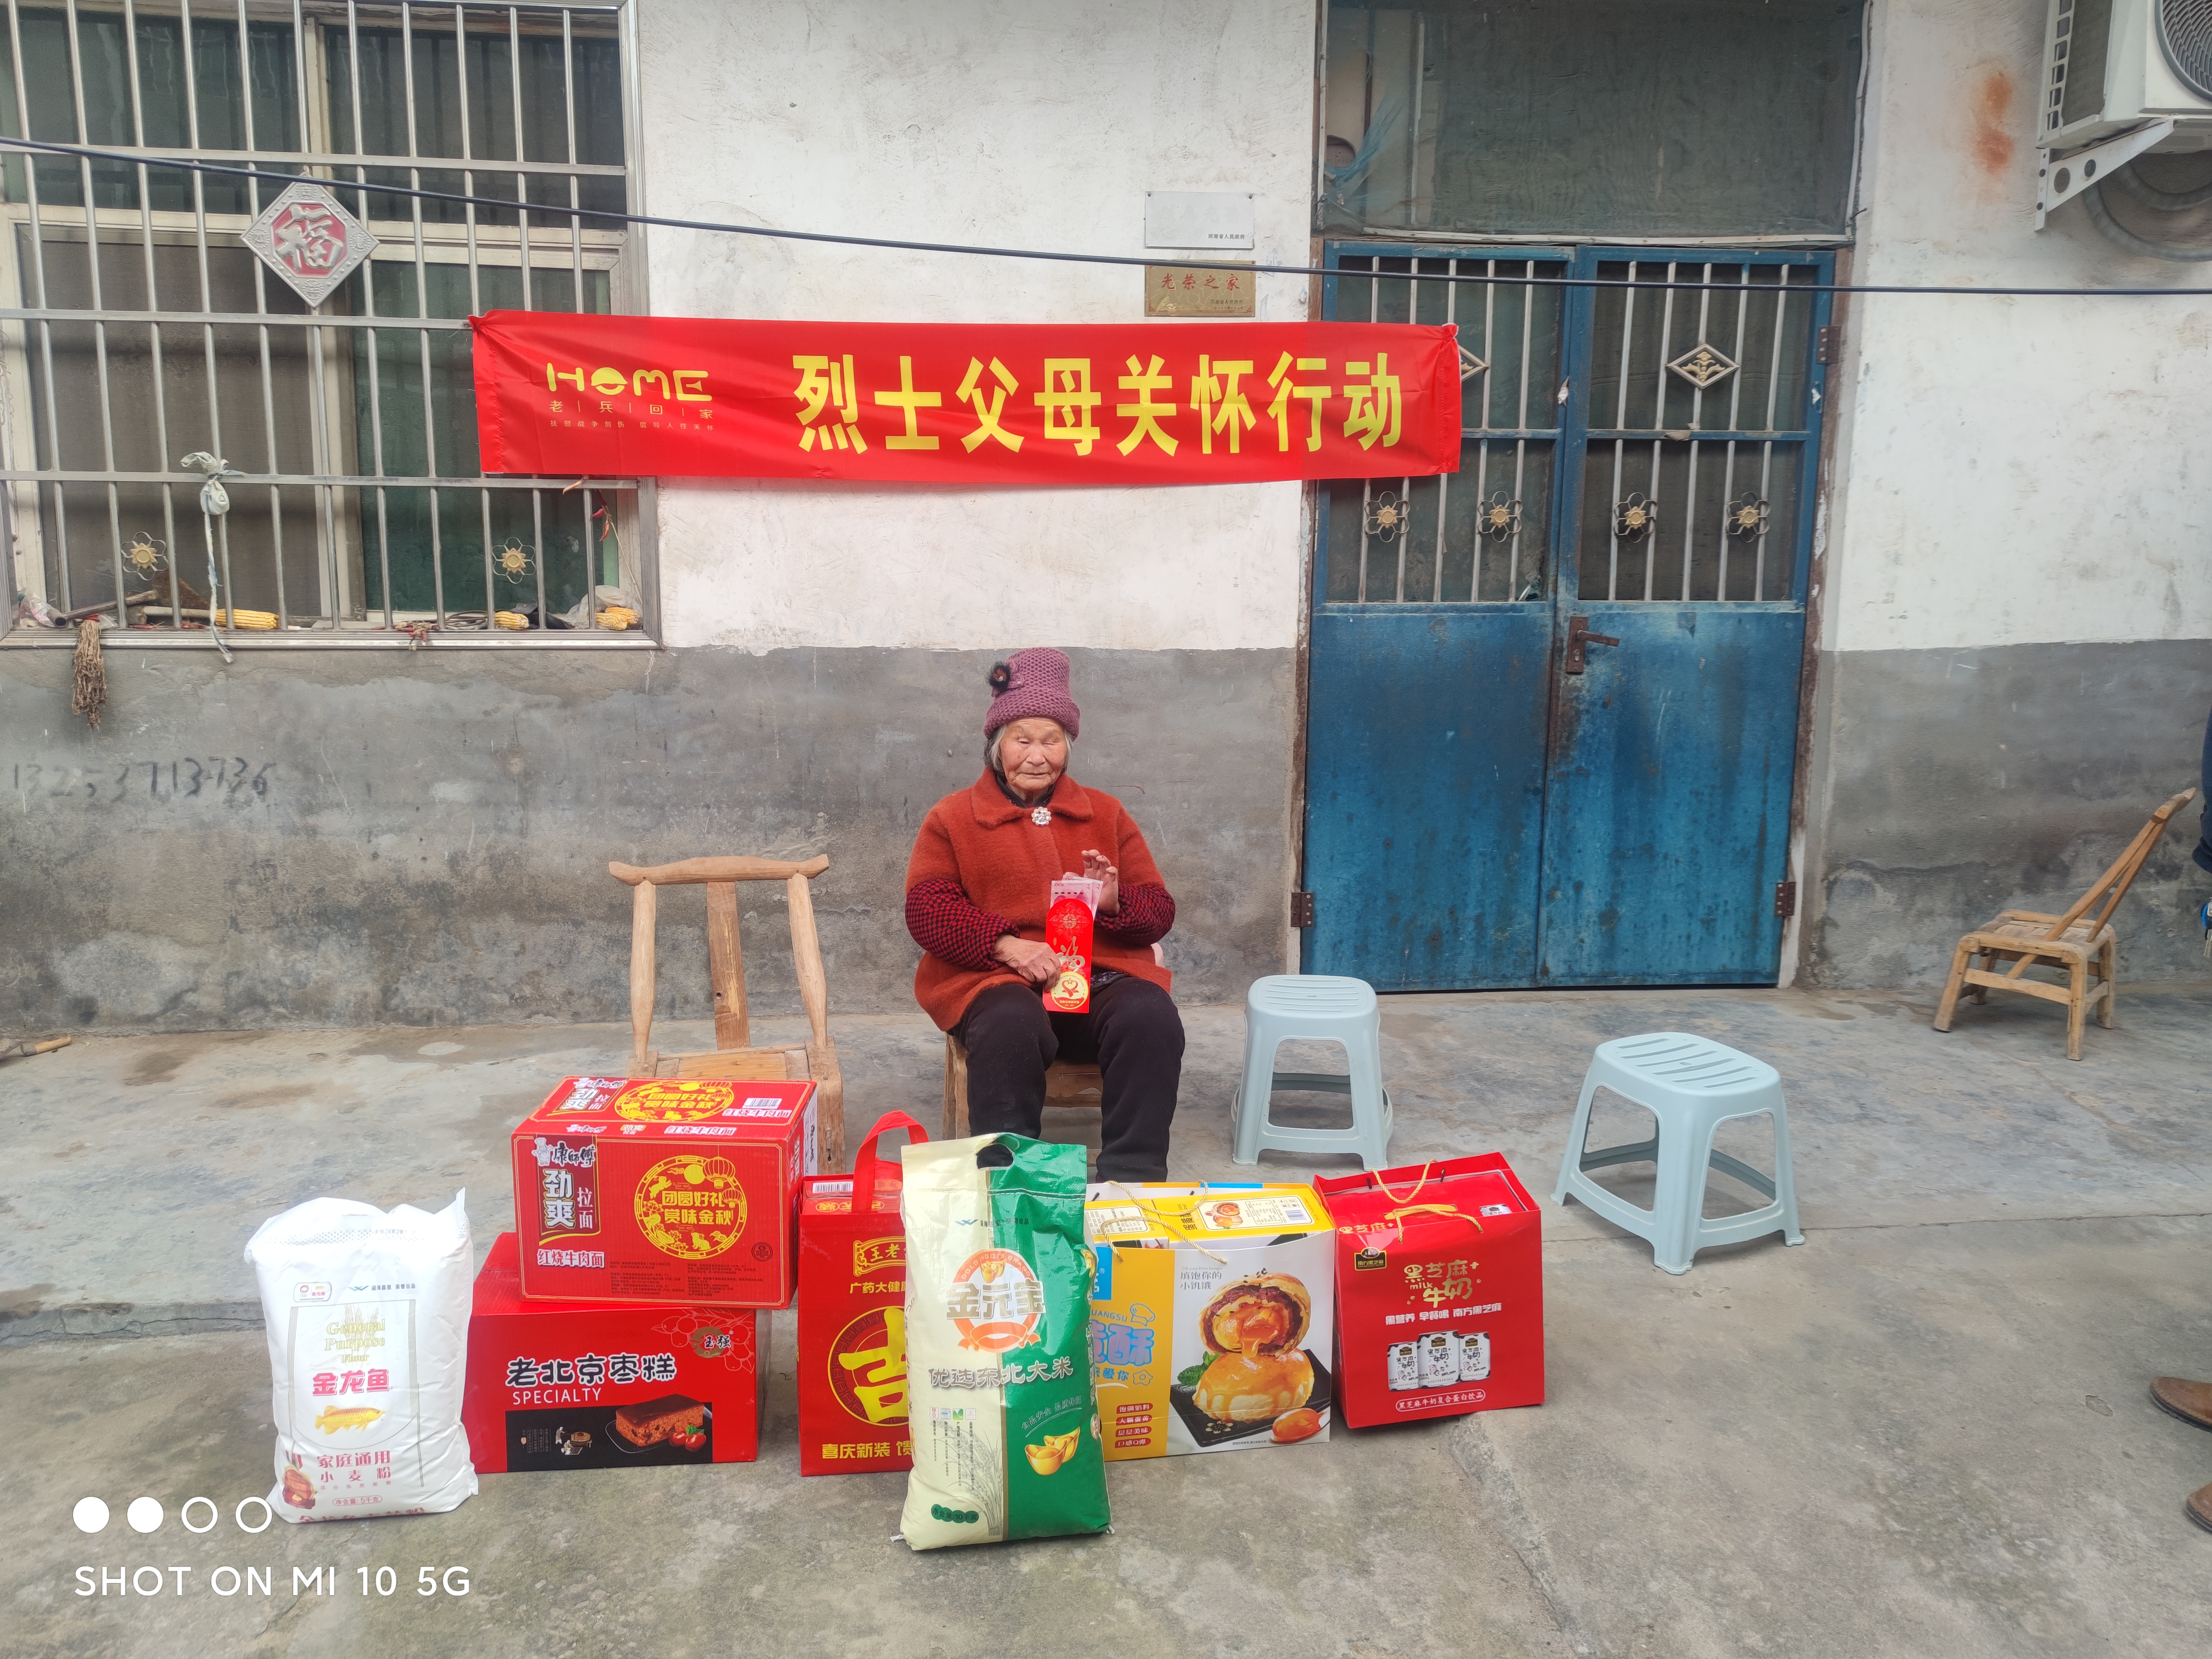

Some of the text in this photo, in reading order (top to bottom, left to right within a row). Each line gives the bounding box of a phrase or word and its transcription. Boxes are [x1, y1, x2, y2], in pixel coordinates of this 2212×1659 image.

[1161, 273, 1240, 291] 光荣之家
[546, 362, 712, 401] HOME
[792, 351, 1402, 456] 烈士父母关怀行动
[640, 422, 714, 431] 倡导人性关怀
[644, 1101, 716, 1109] 赏味金秋
[722, 1108, 792, 1117] 红烧牛肉面
[543, 1169, 575, 1229] 劲爽
[661, 1191, 724, 1207] 团圆好礼
[577, 1187, 593, 1230] 拉面
[663, 1209, 734, 1226] 赏味金秋
[537, 1249, 605, 1268] 红烧牛肉面
[870, 1243, 906, 1262] 王老
[961, 1260, 978, 1280] GOLD
[1008, 1255, 1030, 1276] BRAND
[1180, 1271, 1222, 1280] 填饱你的
[1180, 1281, 1211, 1290] 小饥饿
[1410, 1281, 1433, 1290] milk
[1423, 1277, 1473, 1308] 牛奶
[946, 1278, 1046, 1319] 金元宝
[1385, 1303, 1502, 1326] 黑营养 早餐喝 南方黑芝麻
[327, 1319, 385, 1335] General
[325, 1337, 385, 1351] Purpose
[705, 1334, 731, 1349] 玉强
[341, 1354, 369, 1363] Flour
[506, 1352, 677, 1388] 老北京枣糕
[928, 1356, 1074, 1389] 优选东北大米
[312, 1368, 391, 1396] 金龙鱼
[513, 1388, 602, 1405] SPECIALTY
[1398, 1392, 1484, 1409] 黑芝麻牛奶复合蛋白饮品
[1022, 1395, 1082, 1431] 食品安全 品质保证
[1119, 1404, 1150, 1413] 饱满馅料
[1118, 1427, 1148, 1436] 层层美味
[317, 1450, 391, 1468] 家庭通用
[822, 1442, 890, 1459] 喜庆新装
[320, 1467, 392, 1483] 小麦粉
